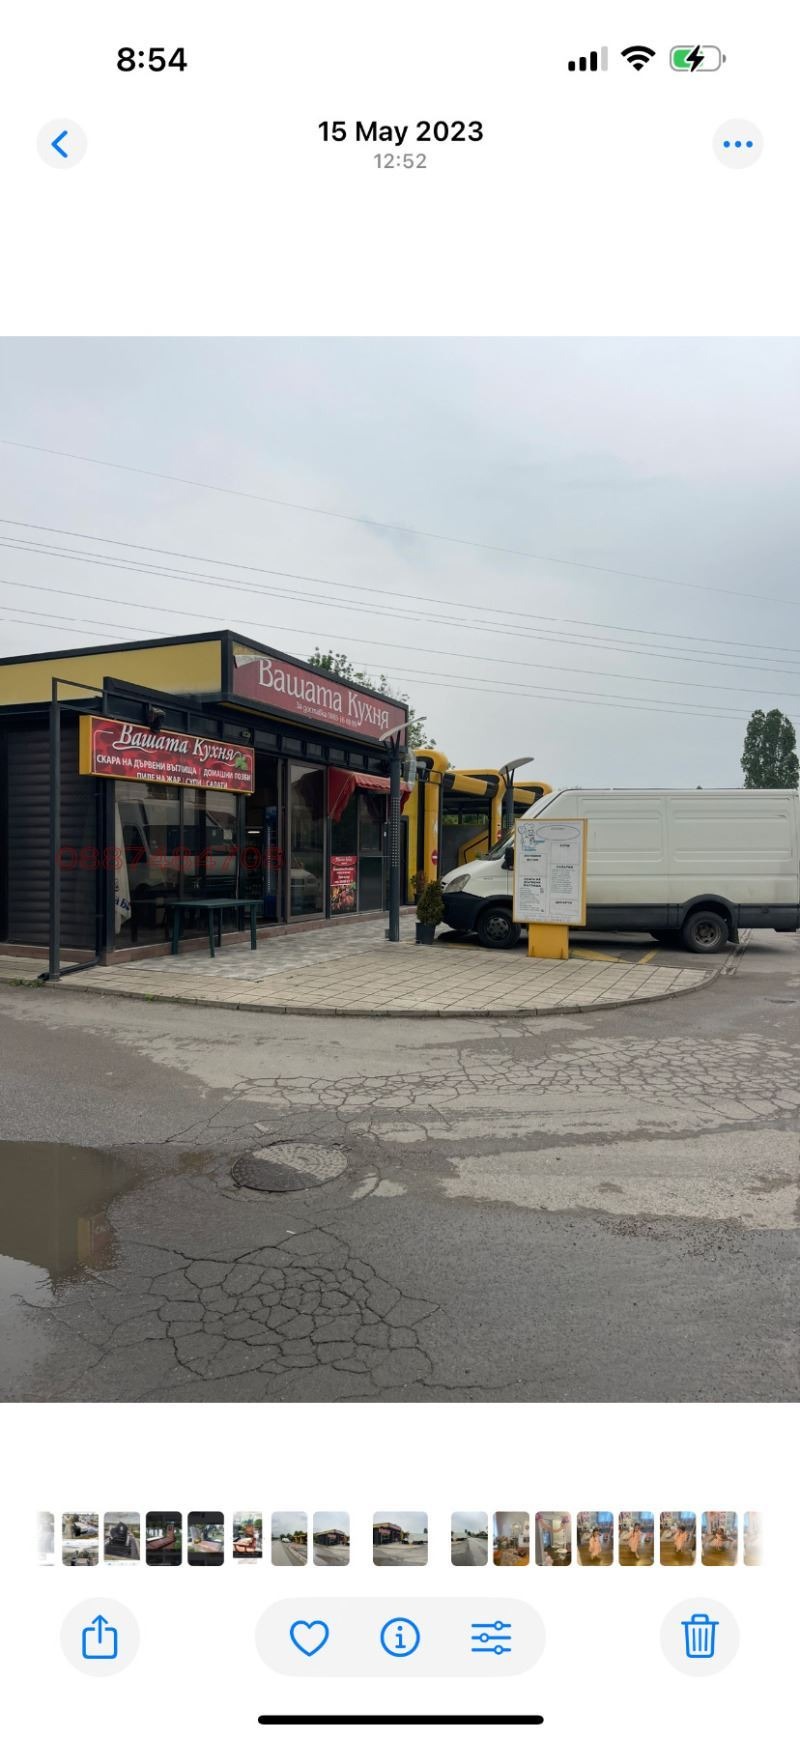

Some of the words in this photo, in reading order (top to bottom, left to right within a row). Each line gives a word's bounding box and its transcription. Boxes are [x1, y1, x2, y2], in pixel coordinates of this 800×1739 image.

[117, 47, 188, 72] 8:54
[319, 121, 346, 141] 15
[356, 121, 408, 146] May
[416, 121, 483, 141] 2023
[375, 154, 426, 168] 12:52
[258, 659, 342, 713] Вашата
[348, 691, 389, 730] Кухня
[113, 724, 188, 754] Вашата
[192, 739, 236, 762] Кухня
[96, 754, 121, 765] СКАРА
[122, 757, 133, 767] НА
[133, 758, 166, 771] ДЪРВЕНИ
[166, 763, 197, 776] ВЪГЛИЩА
[203, 768, 234, 779] ДОМАШНИ
